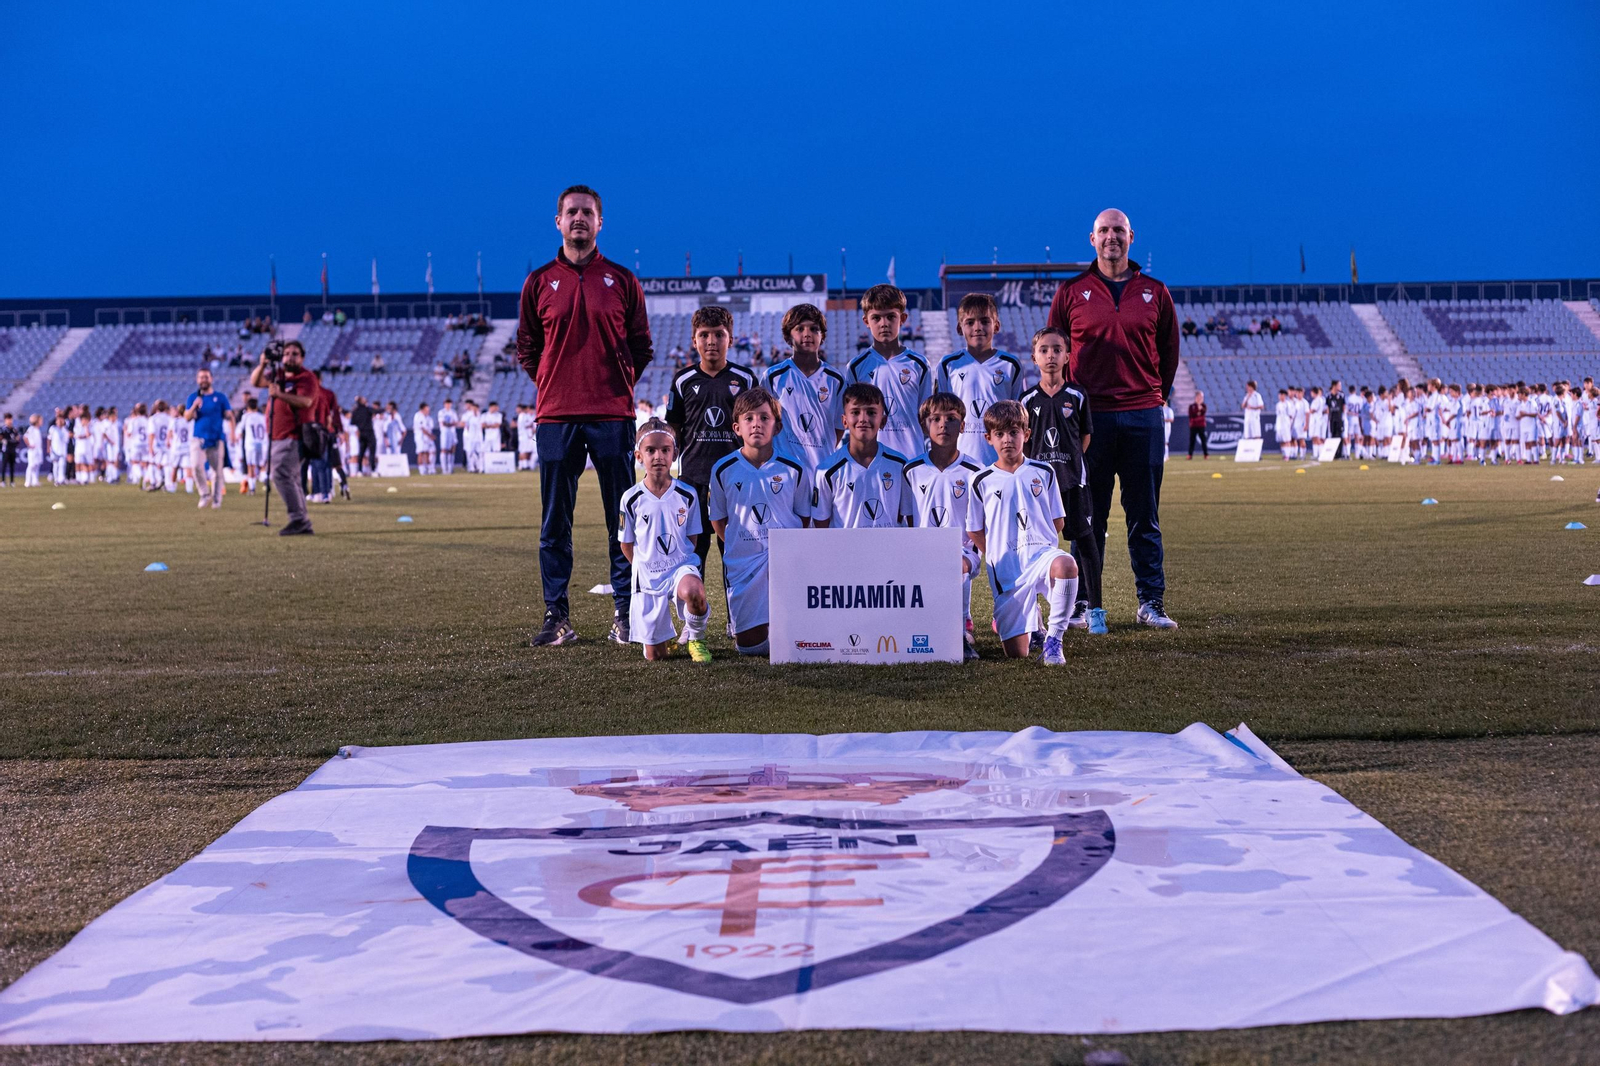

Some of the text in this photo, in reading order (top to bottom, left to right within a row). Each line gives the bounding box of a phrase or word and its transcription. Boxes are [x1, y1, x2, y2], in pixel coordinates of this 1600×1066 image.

[667, 280, 702, 292] CLIMA
[731, 277, 797, 290] JAÉN CLIMA
[159, 425, 168, 441] 6
[251, 424, 264, 440] 10
[807, 580, 924, 609] BENJAMÍN A
[608, 832, 917, 855] JAÉN
[681, 943, 815, 960] 1922
